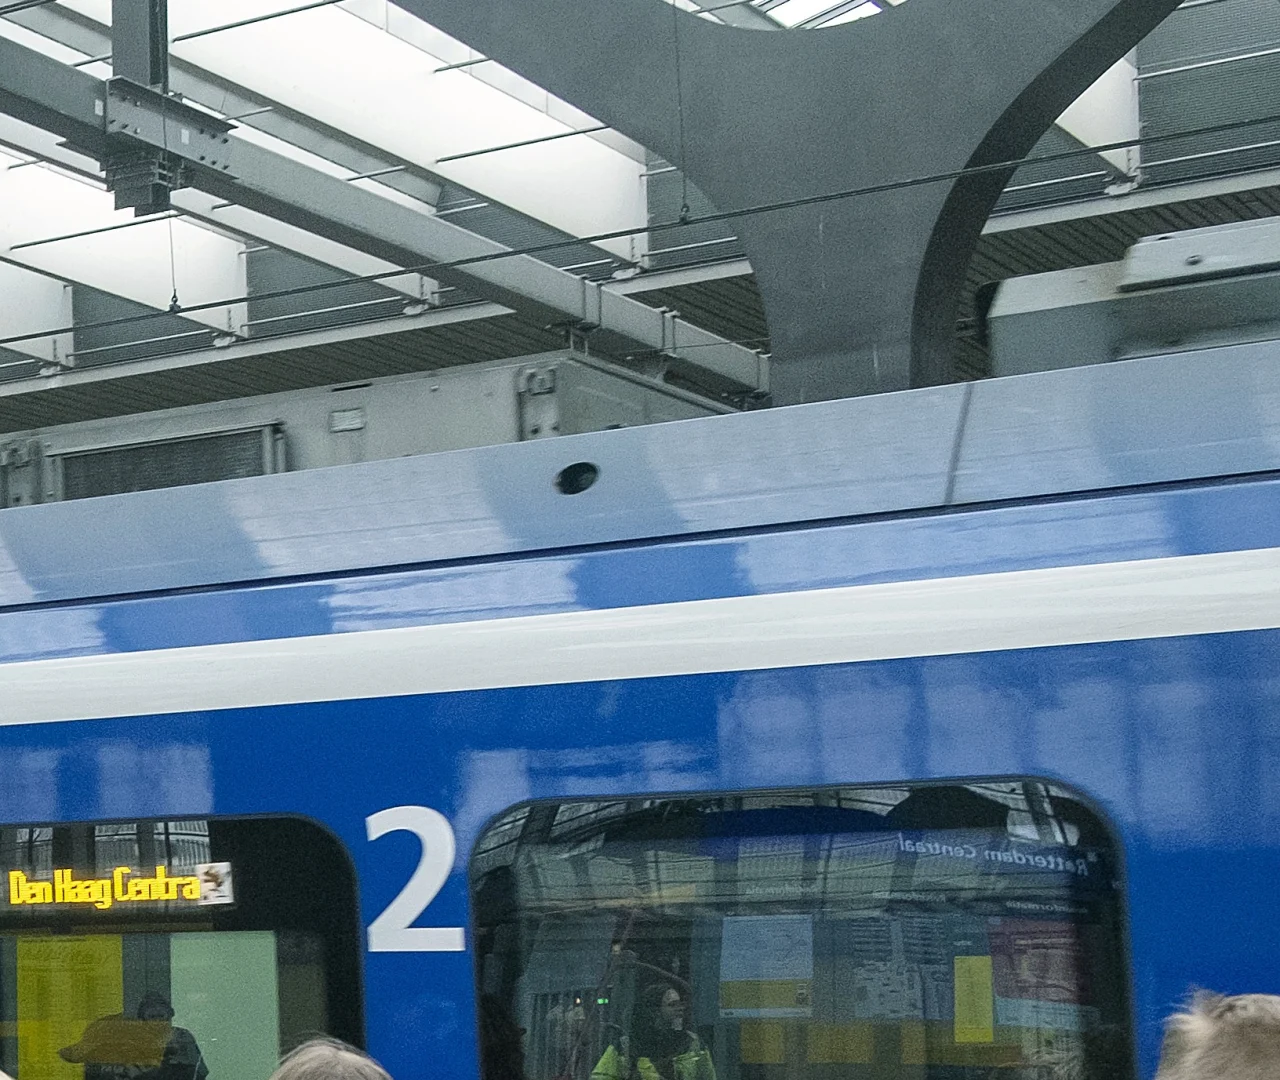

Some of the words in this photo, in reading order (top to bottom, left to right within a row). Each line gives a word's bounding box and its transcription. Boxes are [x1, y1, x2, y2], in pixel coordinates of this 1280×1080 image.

[8, 870, 53, 906] Den
[54, 867, 113, 910] Haag
[365, 805, 466, 953] 2
